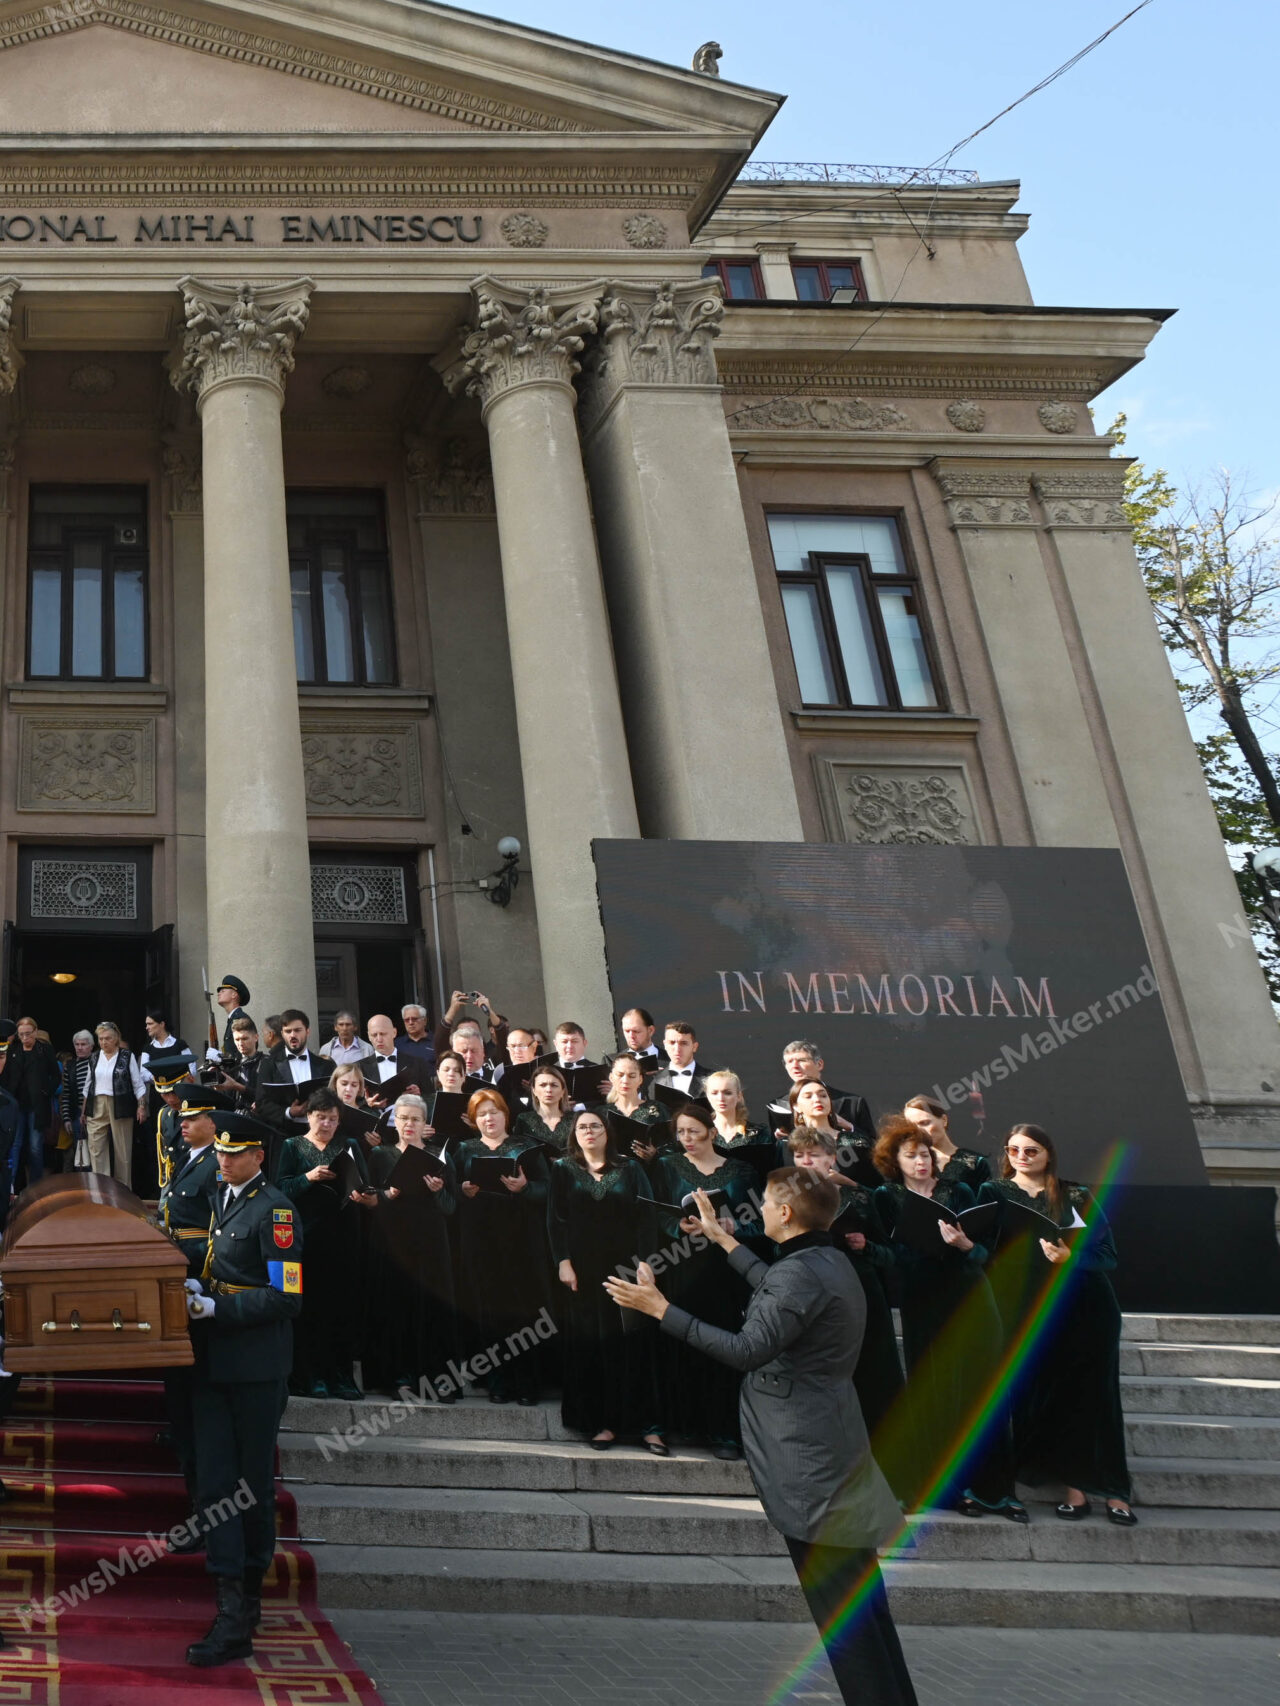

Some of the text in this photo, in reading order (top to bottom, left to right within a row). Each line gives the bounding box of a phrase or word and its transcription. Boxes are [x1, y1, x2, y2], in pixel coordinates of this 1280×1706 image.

[134, 214, 254, 242] MIHAI
[282, 215, 482, 242] EMINESCU
[715, 970, 1059, 1018] IN MEMORIAM
